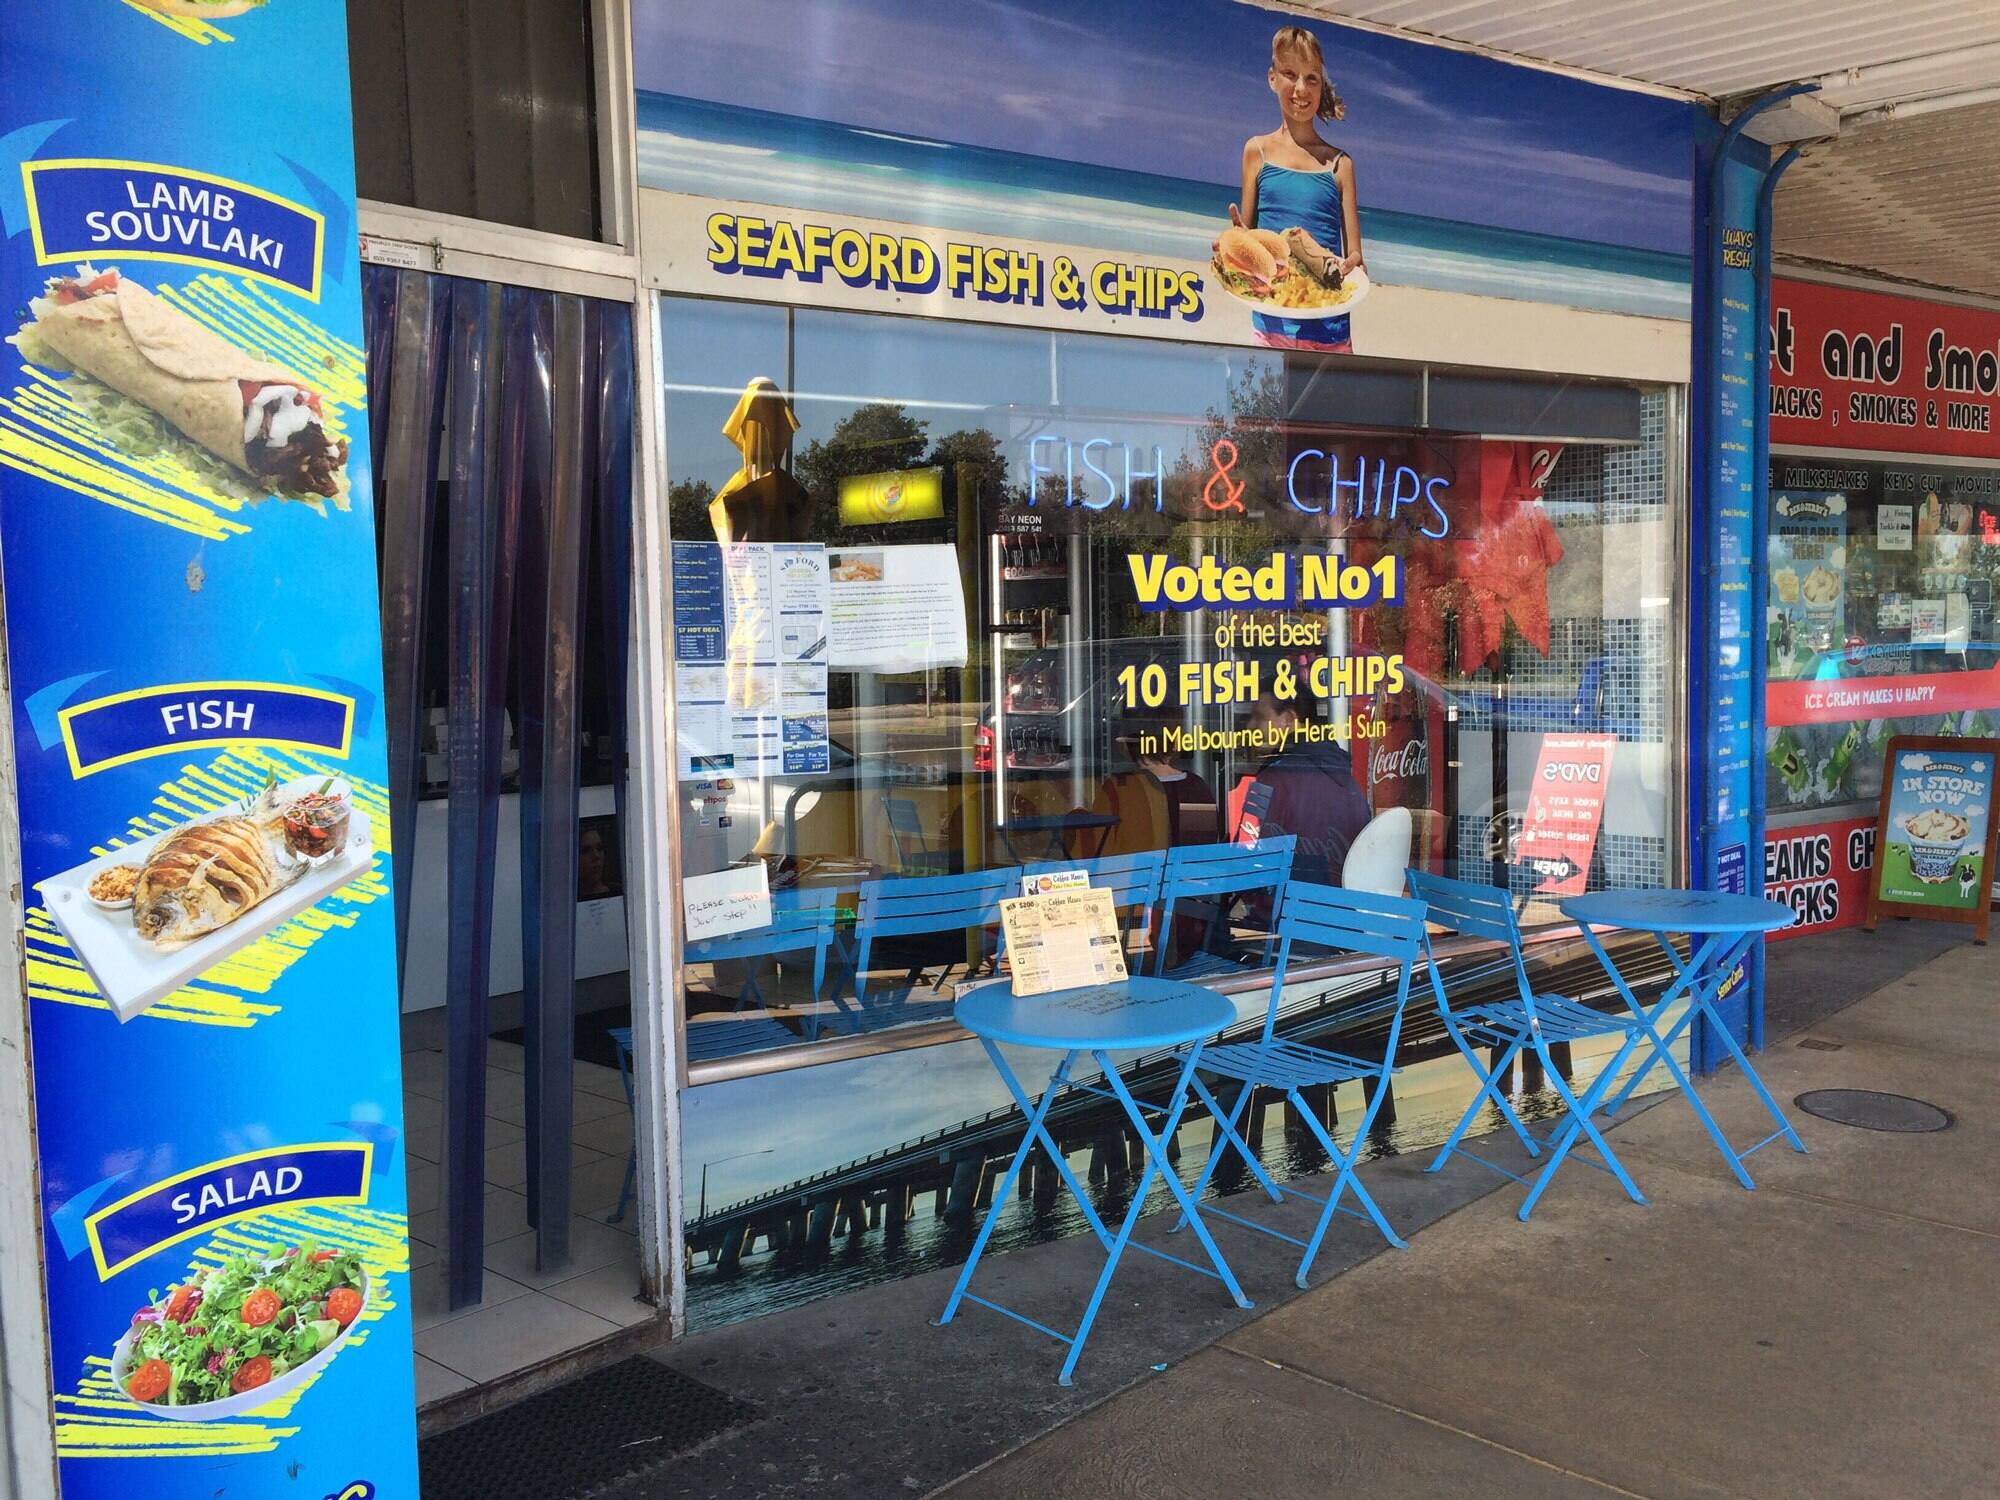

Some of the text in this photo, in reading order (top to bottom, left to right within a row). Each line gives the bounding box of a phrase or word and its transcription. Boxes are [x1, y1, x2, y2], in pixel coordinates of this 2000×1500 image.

[125, 180, 236, 222] LAMB
[86, 210, 284, 270] SOUVLAKI
[706, 212, 1205, 323] SEAFORD FISH & CHIPS
[1821, 323, 1903, 386] and
[1925, 328, 2000, 396] Smo
[1850, 393, 1917, 428] SMOKES
[1925, 399, 1939, 429] &
[1947, 401, 1990, 433] MORE
[1026, 434, 1164, 512] FISH
[1203, 438, 1247, 513] &
[1286, 448, 1451, 540] CHIPS
[1784, 467, 1869, 490] MILKSHAKES
[1883, 471, 1914, 491] KEYS
[1920, 474, 1942, 493] CUT
[1955, 476, 1992, 493] MOVIE
[1018, 515, 1042, 524] NEON
[1126, 552, 1405, 612] Voted No1
[1214, 614, 1322, 648] of the best
[1117, 654, 1404, 709] 10 FISH & CHIPS
[1804, 686, 1936, 710] ICE CREAM MAKES U HAPPY
[160, 699, 255, 735] FISH
[1140, 715, 1386, 755] in Melbourne by Herad Sun
[1902, 776, 1985, 796] IN STORE
[1918, 789, 1966, 805] NOW
[688, 899, 724, 914] PLEASE
[171, 1166, 303, 1224] SALAD
